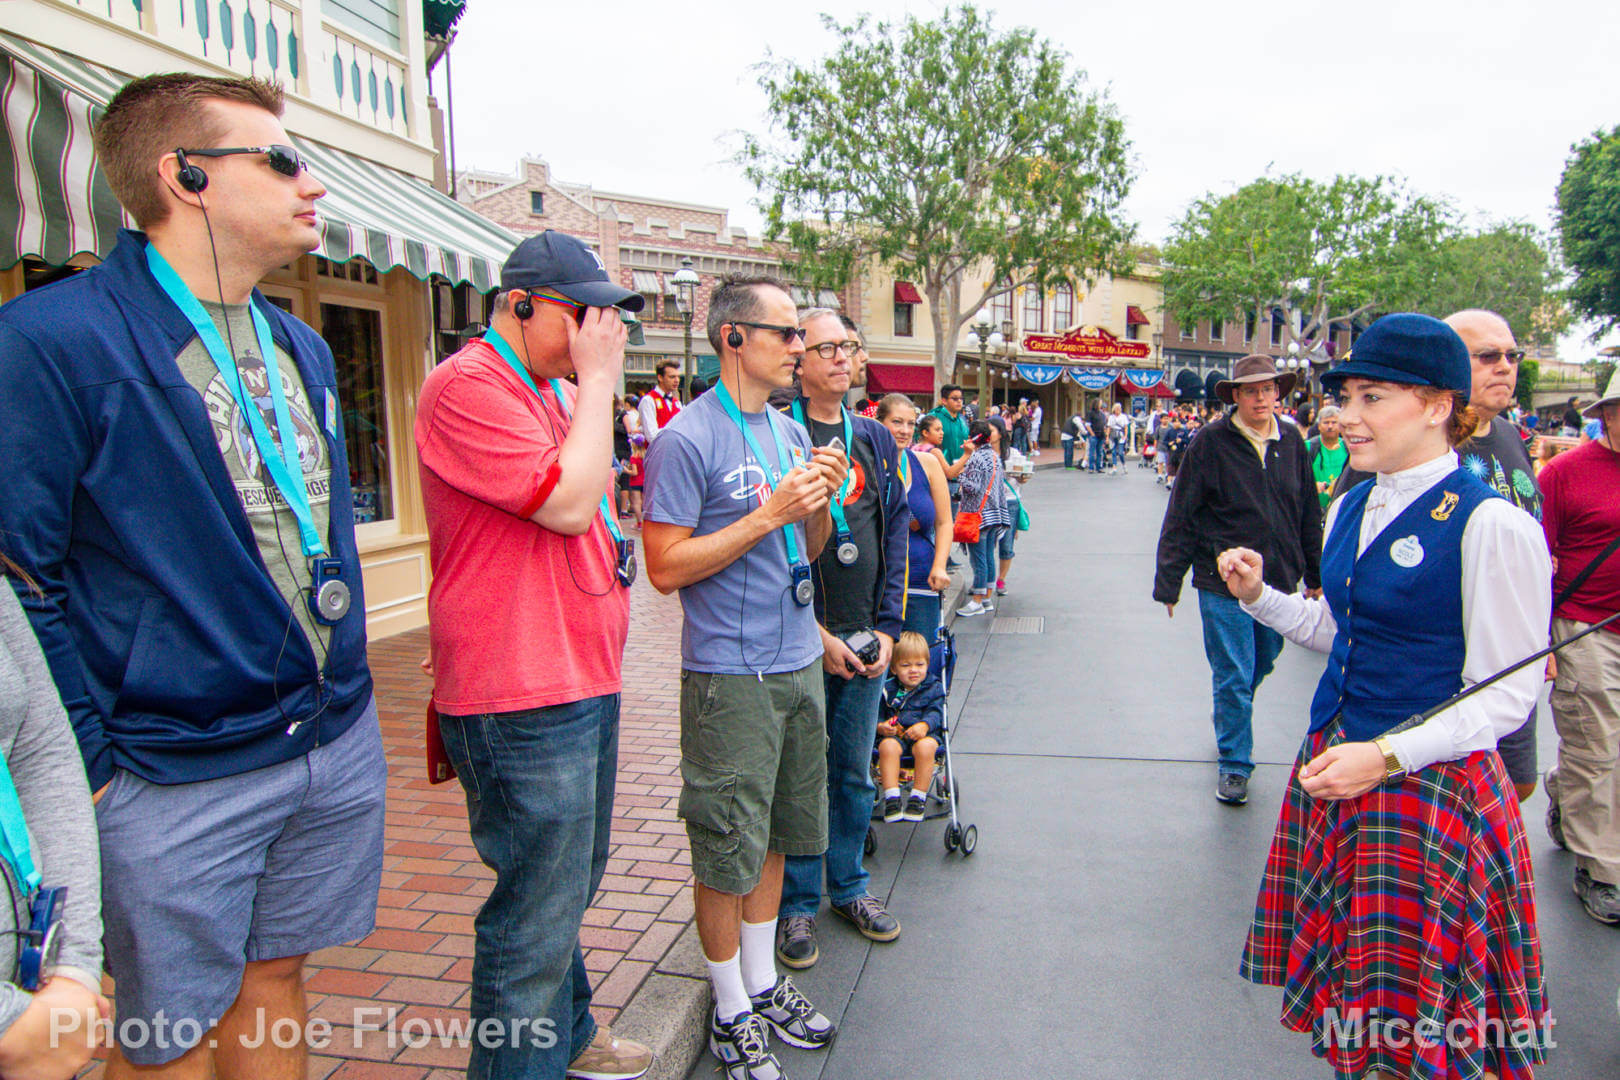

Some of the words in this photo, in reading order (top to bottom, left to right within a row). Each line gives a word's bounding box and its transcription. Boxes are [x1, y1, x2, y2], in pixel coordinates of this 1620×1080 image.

[1030, 340, 1053, 351] GREAT
[1054, 341, 1086, 353] MOMENTS
[1088, 345, 1104, 354] WITH
